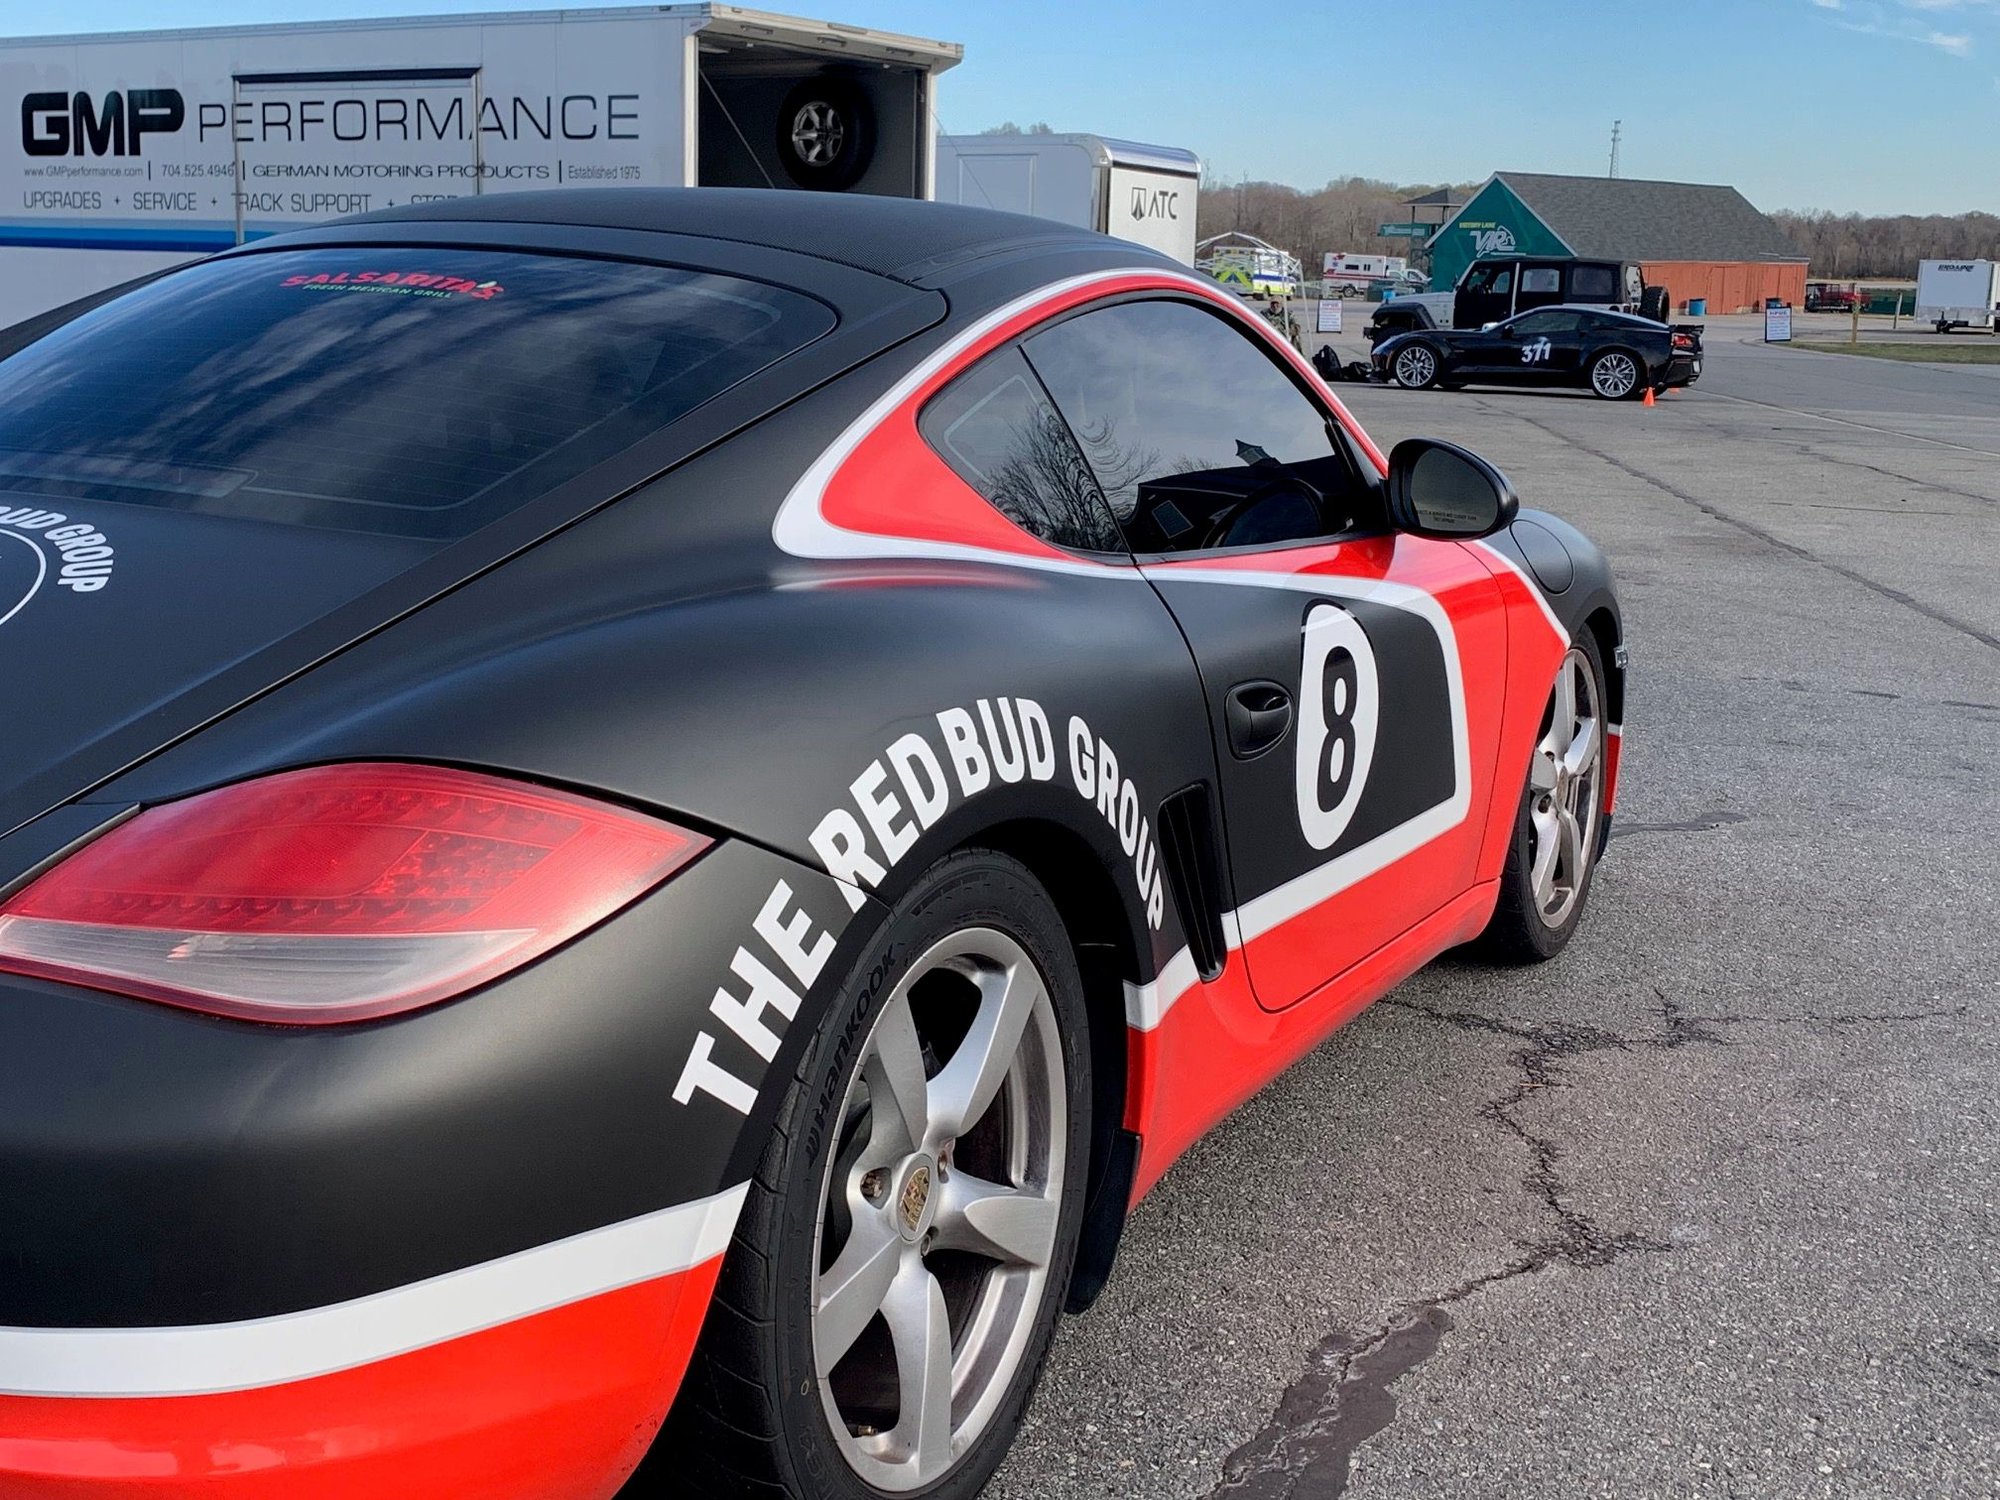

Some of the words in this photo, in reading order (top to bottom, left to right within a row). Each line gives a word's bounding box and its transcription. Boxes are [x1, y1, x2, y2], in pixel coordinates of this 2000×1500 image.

[21, 89, 185, 156] GMP
[199, 94, 640, 142] PERFORMANCE
[252, 165, 330, 178] GERMAN
[333, 165, 433, 178] MOTORING
[437, 164, 550, 180] PRODUCTS
[568, 165, 617, 180] Established
[619, 165, 641, 180] 1975
[23, 191, 102, 211] UPGRADES
[132, 192, 198, 211] SERVICE
[290, 193, 372, 213] SUPPORT
[1148, 190, 1178, 220] ATC
[302, 283, 346, 291] FRESH
[348, 285, 410, 295] MEXICAN
[414, 290, 453, 299] GRILL
[44, 523, 114, 592] GROUP
[1316, 645, 1358, 813] 8
[671, 878, 837, 1117] THE
[807, 733, 950, 914] RED
[935, 696, 1056, 798] BUD
[1068, 715, 1164, 931] GROUP
